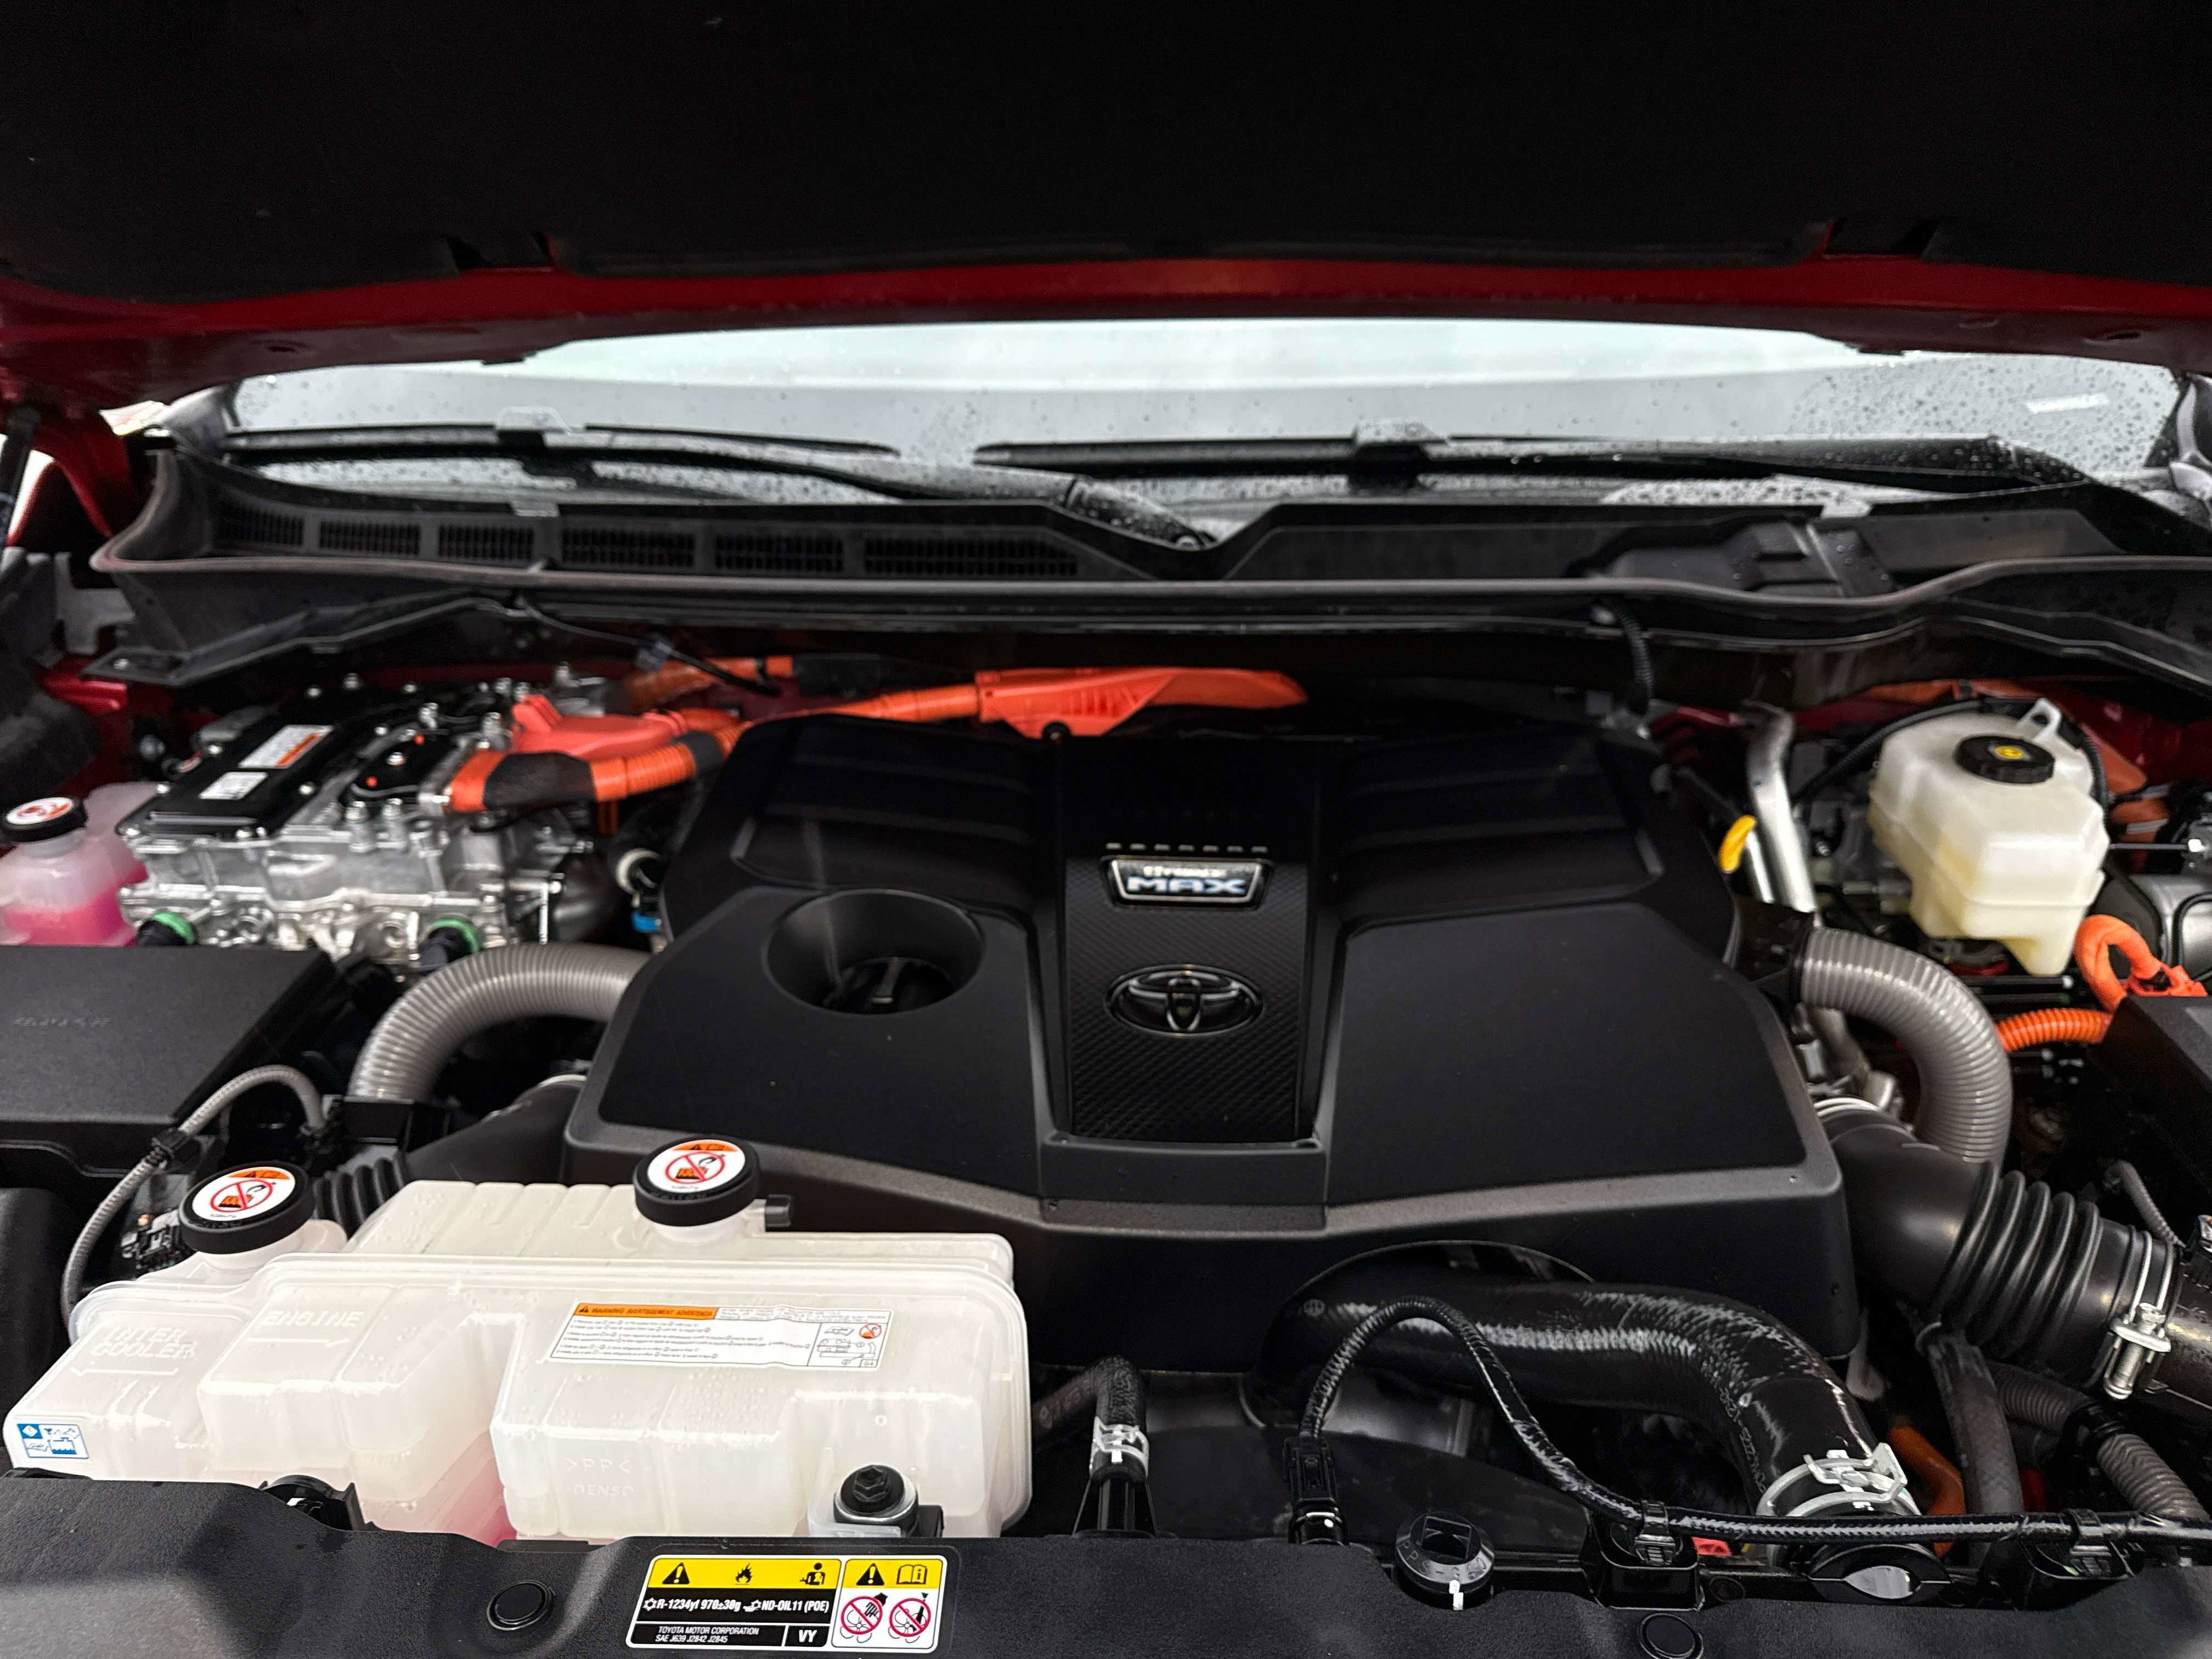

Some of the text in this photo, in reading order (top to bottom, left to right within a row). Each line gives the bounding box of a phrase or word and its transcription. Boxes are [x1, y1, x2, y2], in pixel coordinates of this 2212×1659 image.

[262, 1311, 364, 1327] ENGINE
[104, 1326, 188, 1342] INTER
[91, 1340, 196, 1359] COOLER
[657, 1599, 700, 1612] R-1234yf
[761, 1600, 803, 1611] ND-OIL11
[804, 1601, 830, 1613] (POE)
[798, 1629, 817, 1643] VY
